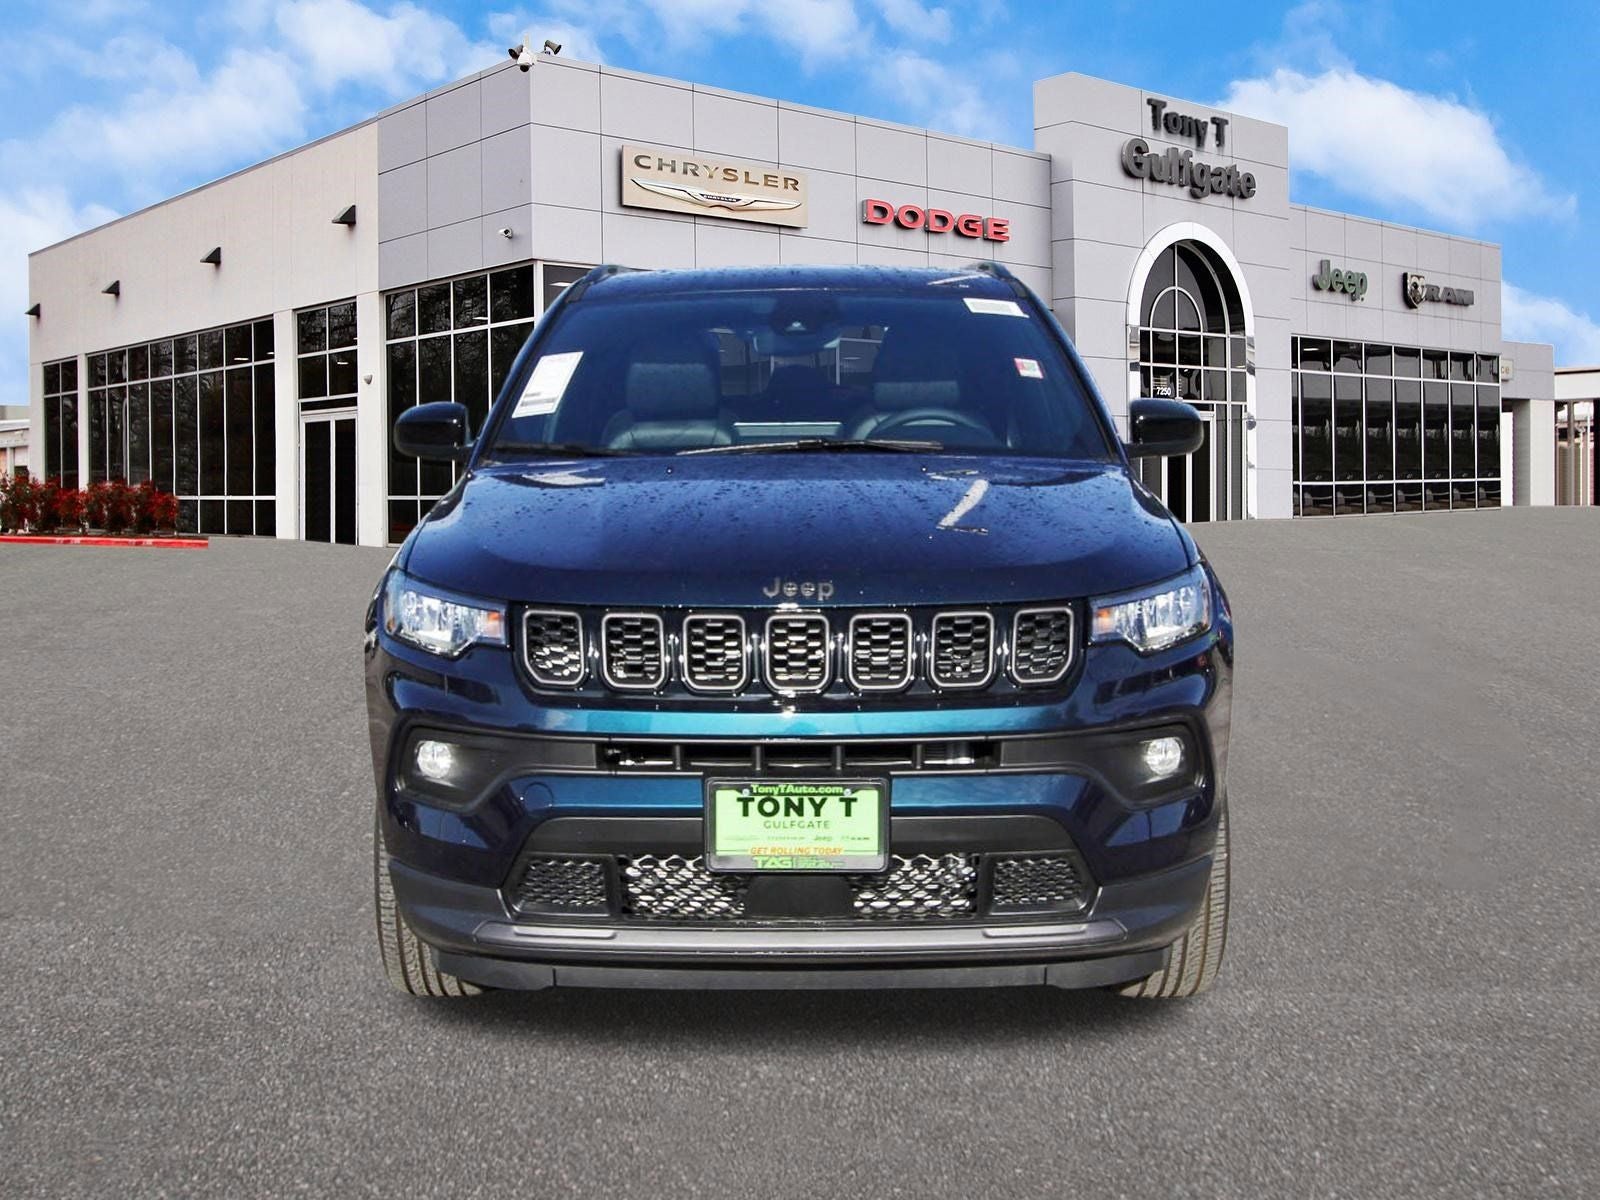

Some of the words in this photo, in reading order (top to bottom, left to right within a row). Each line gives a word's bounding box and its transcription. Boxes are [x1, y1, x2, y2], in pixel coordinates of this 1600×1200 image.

[1146, 98, 1209, 148] Tony
[1211, 117, 1229, 147] T
[633, 154, 800, 191] CHRYSLER
[1121, 138, 1256, 199] Gulfgate
[863, 198, 1010, 242] DODGE
[1313, 259, 1368, 301] Jeep
[1424, 284, 1475, 306] RAM
[1156, 386, 1171, 396] 7250
[763, 578, 834, 601] Jeep
[751, 784, 844, 796] TonyTAuto.com
[737, 797, 827, 817] TONY
[839, 797, 858, 817] T
[763, 820, 830, 829] GULFGATE
[751, 847, 767, 855] GET
[770, 847, 810, 855] ROLLING
[814, 847, 844, 855] TODAY
